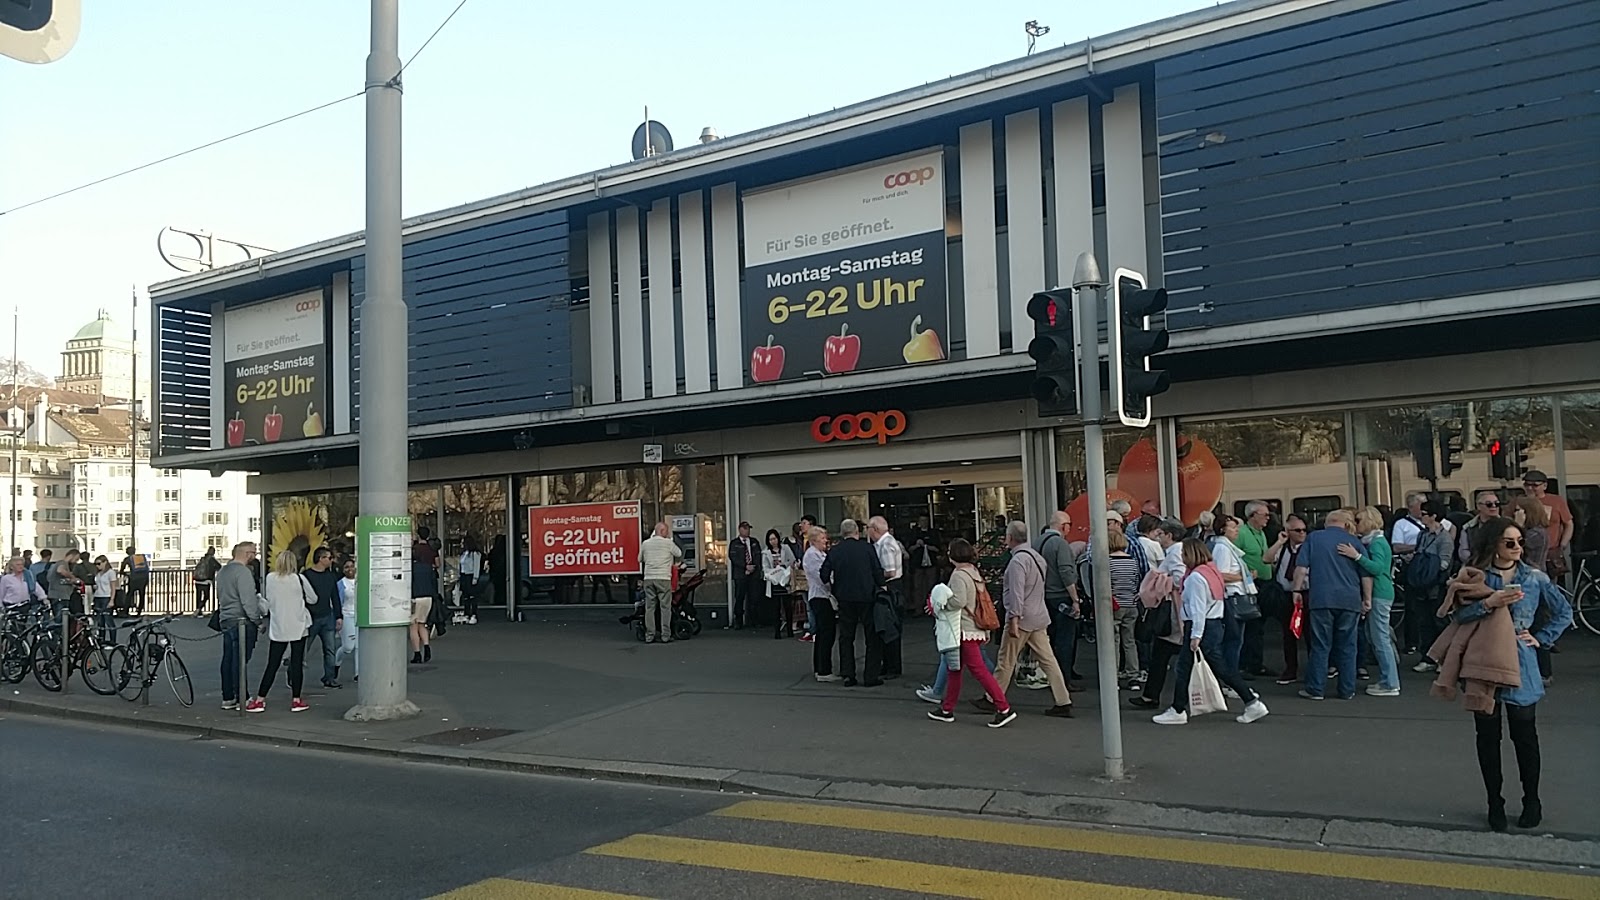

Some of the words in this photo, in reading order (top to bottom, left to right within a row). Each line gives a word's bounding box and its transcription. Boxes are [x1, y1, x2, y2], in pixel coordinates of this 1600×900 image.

[884, 166, 935, 189] coop
[766, 239, 791, 254] Für
[795, 233, 818, 248] Sie
[821, 218, 894, 246] geöffnet.
[766, 247, 924, 289] Montag-Samstag
[856, 277, 925, 310] Uhr
[296, 299, 320, 312] coop
[236, 343, 250, 353] Für
[251, 340, 263, 351] Sie
[264, 333, 301, 350] geöffnet.
[236, 355, 315, 378] Montag-Samstag
[281, 374, 315, 396] Uhr
[811, 410, 906, 444] coop
[543, 514, 602, 525] Montag-Samstag
[615, 506, 638, 515] coop
[587, 527, 620, 545] Uhr
[544, 547, 624, 570] geöffnet!
